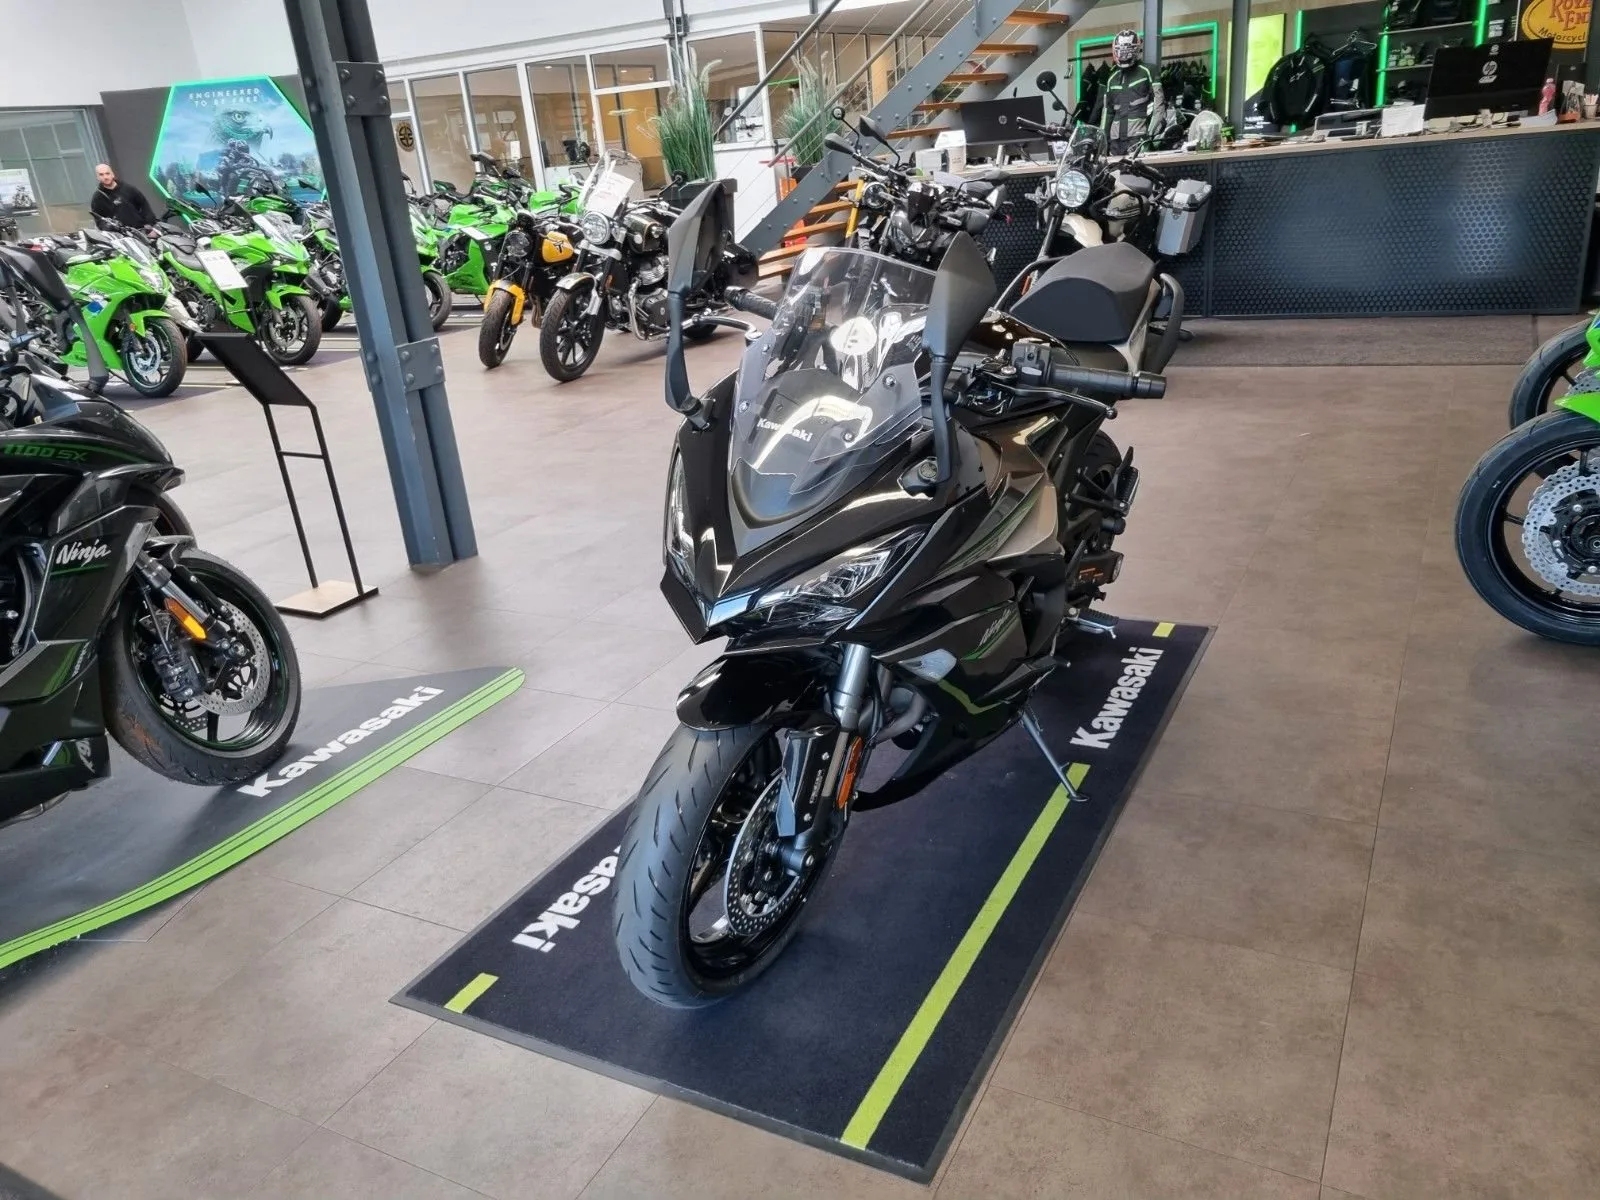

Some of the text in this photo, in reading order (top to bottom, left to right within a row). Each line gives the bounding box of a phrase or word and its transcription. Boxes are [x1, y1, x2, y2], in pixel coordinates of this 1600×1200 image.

[194, 100, 208, 108] TO
[56, 539, 111, 568] Ninja
[236, 685, 445, 798] Kawasaki
[1069, 646, 1165, 750] Kawasaki
[511, 845, 621, 953] asaki
